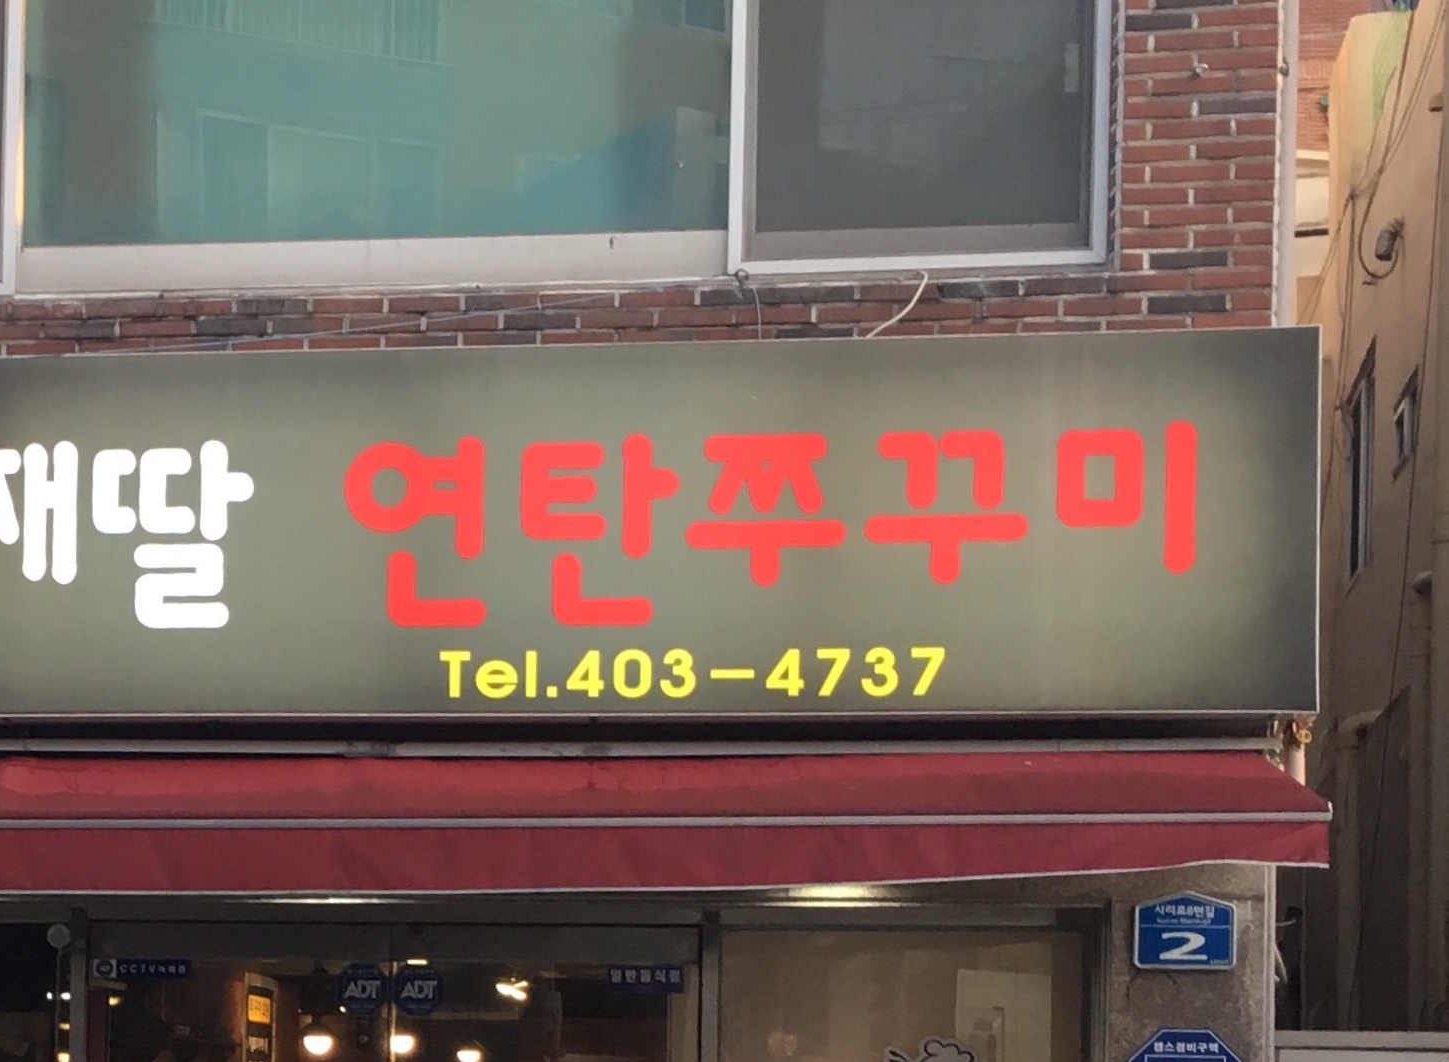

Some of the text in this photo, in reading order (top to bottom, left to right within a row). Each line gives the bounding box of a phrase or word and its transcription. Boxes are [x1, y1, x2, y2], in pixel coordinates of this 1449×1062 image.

[344, 419, 1197, 628] 연탄쭈꾸미
[1159, 931, 1208, 961] 2
[345, 979, 381, 999] ADT
[401, 979, 438, 999] ADT
